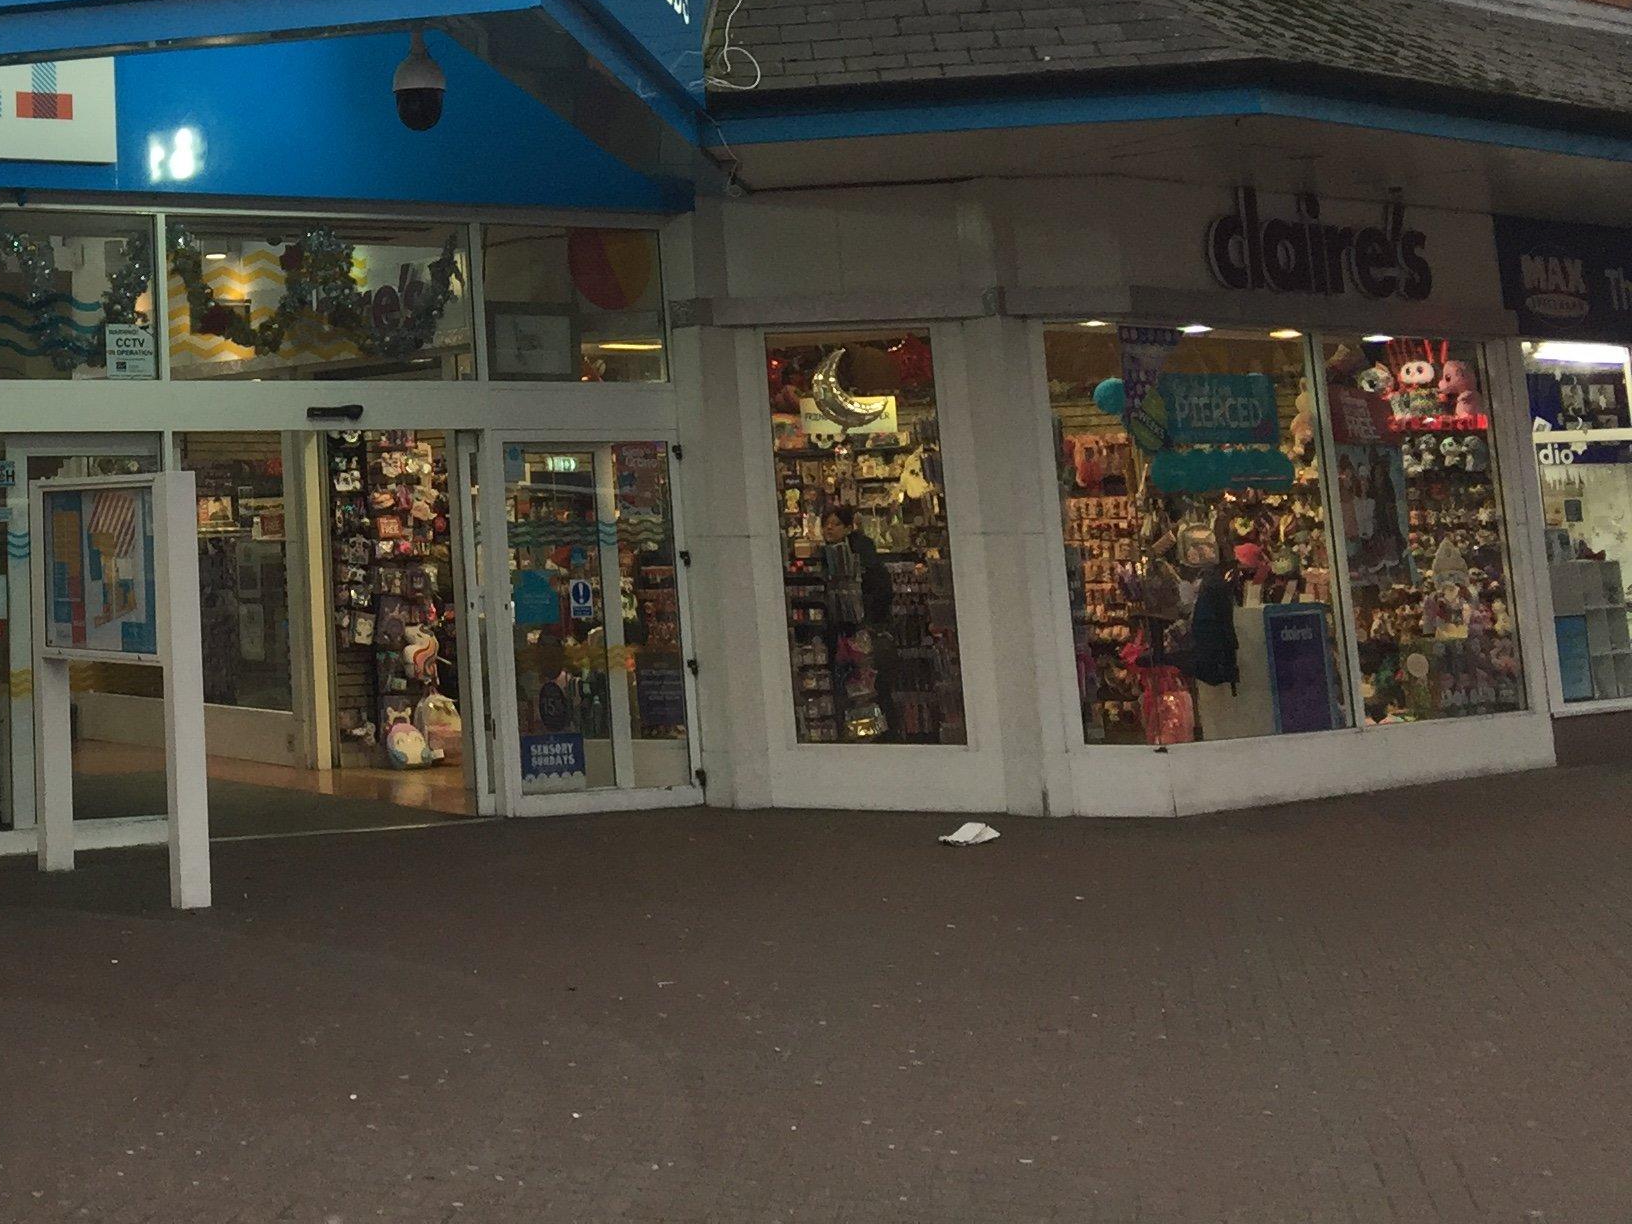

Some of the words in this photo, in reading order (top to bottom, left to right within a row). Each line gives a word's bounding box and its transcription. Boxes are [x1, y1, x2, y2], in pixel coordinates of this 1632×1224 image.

[1204, 186, 1433, 301] claire's
[1520, 254, 1587, 293] MAX
[115, 337, 145, 348] CCTV
[1174, 392, 1264, 428] PIERCED
[1539, 443, 1574, 465] dio
[529, 742, 575, 755] SENSORY
[530, 753, 577, 768] SUNDAYS
